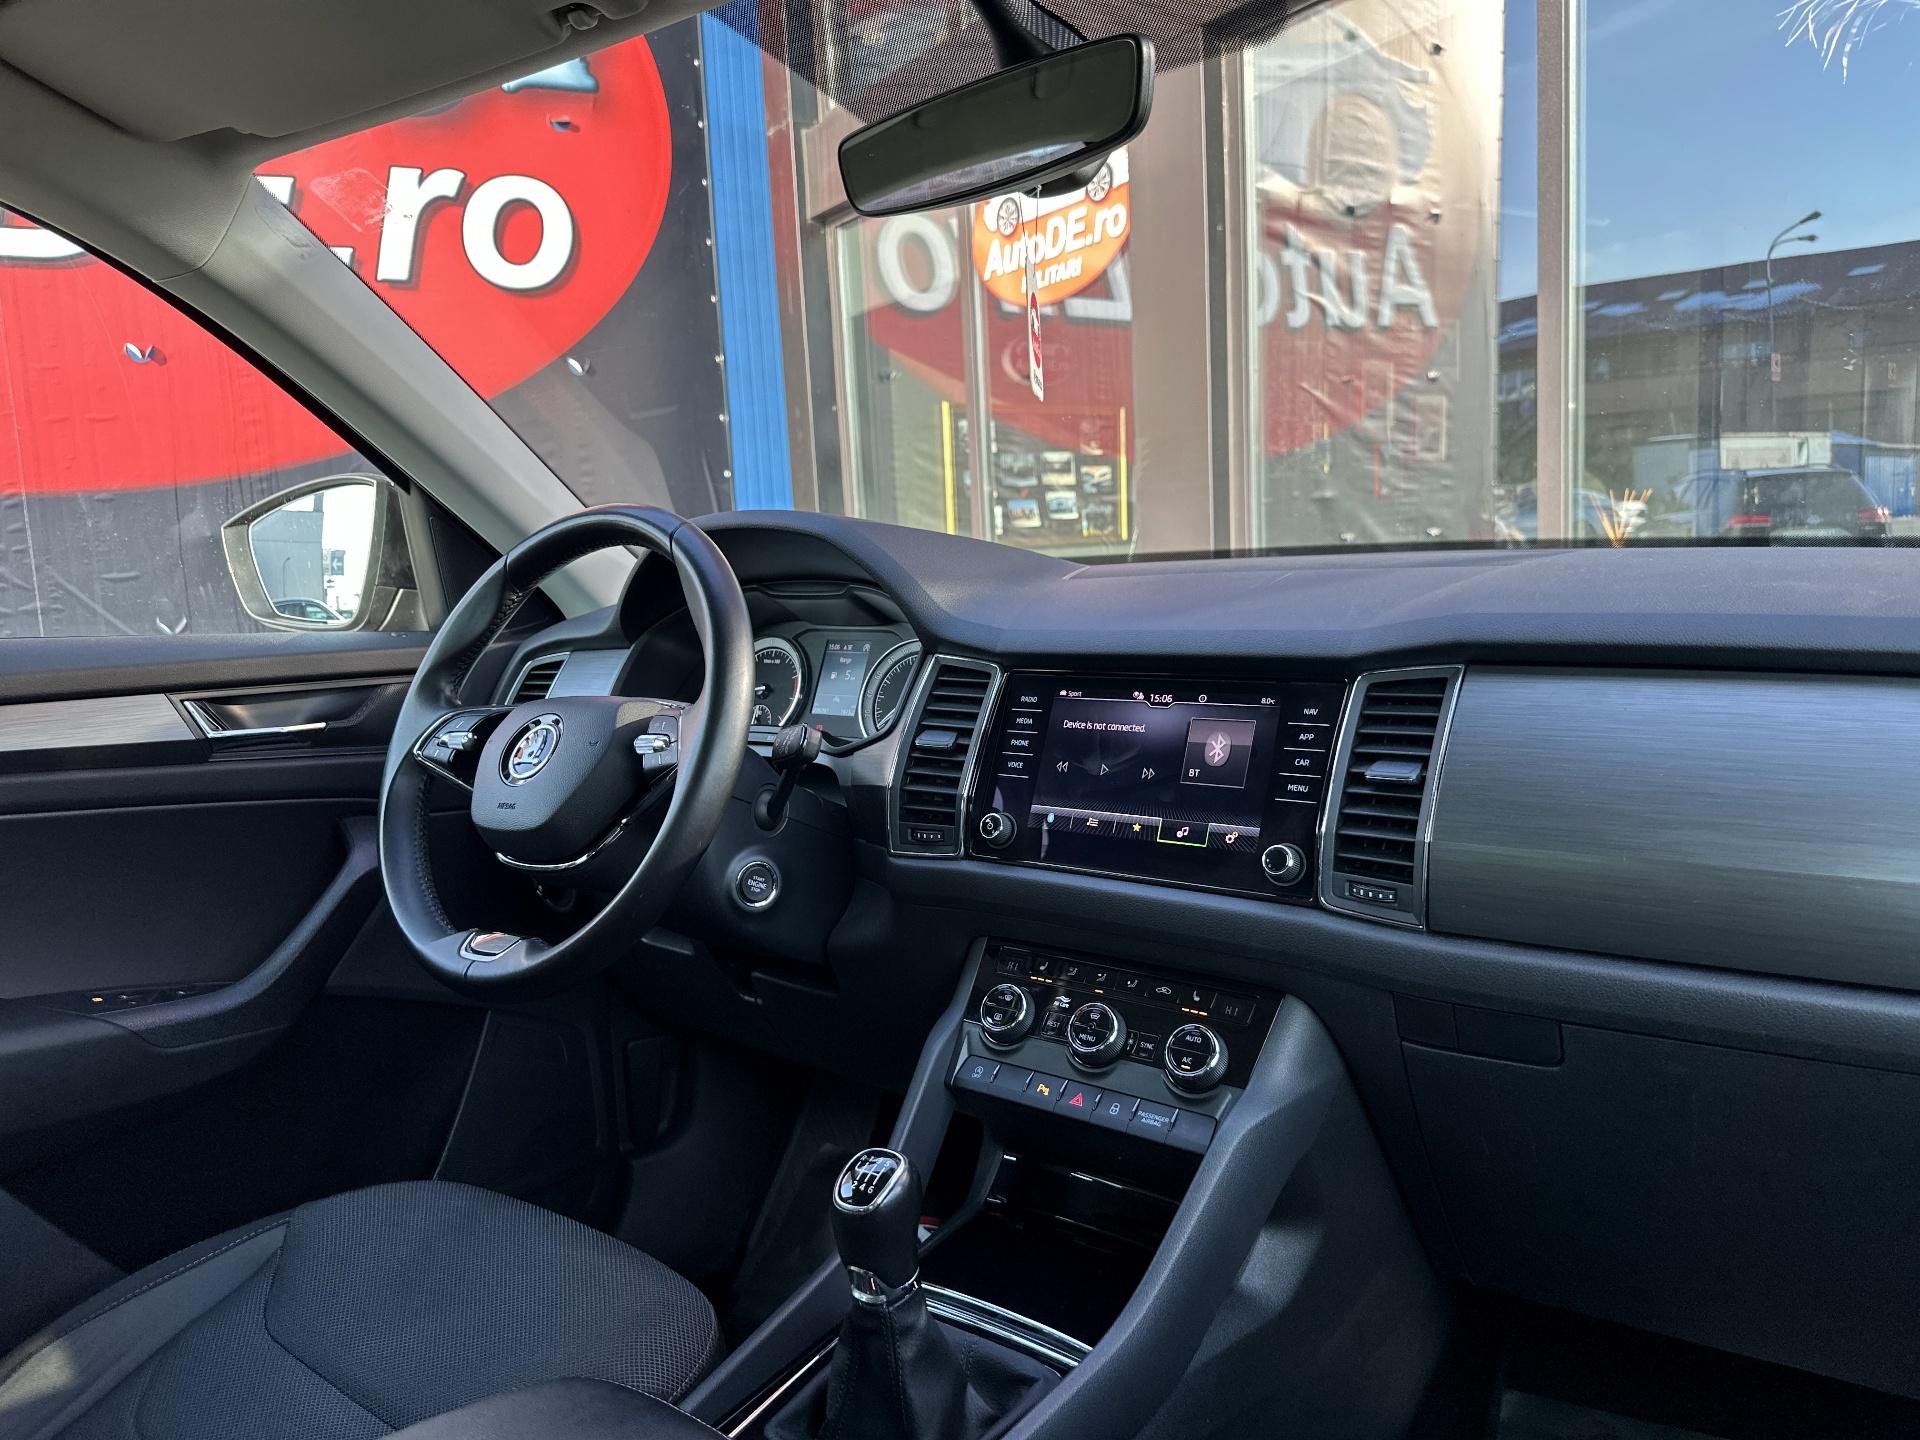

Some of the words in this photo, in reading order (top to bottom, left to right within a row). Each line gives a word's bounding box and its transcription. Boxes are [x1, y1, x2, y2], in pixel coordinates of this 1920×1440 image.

[256, 165, 576, 291] .ro
[984, 203, 1127, 281] AutoDE.ro
[1020, 695, 1038, 703] RADIO
[1150, 694, 1173, 703] 15:06
[1303, 708, 1319, 716] NAV
[1015, 717, 1033, 725] MEDIA
[1063, 719, 1086, 730] Device
[1094, 722, 1106, 731] not
[1107, 724, 1146, 733] connected.
[1299, 733, 1315, 741] APP
[1010, 739, 1030, 747] PHONE
[1007, 761, 1024, 769] VOICE
[1295, 758, 1310, 766] CAR
[1188, 768, 1200, 777] BT
[1287, 783, 1309, 793] MENU
[747, 879, 767, 890] ENGINE
[1078, 1033, 1096, 1042] MENU
[1185, 1034, 1202, 1043] AUTO
[1140, 1041, 1155, 1050] SYNC
[1137, 1110, 1170, 1123] PASSENGER
